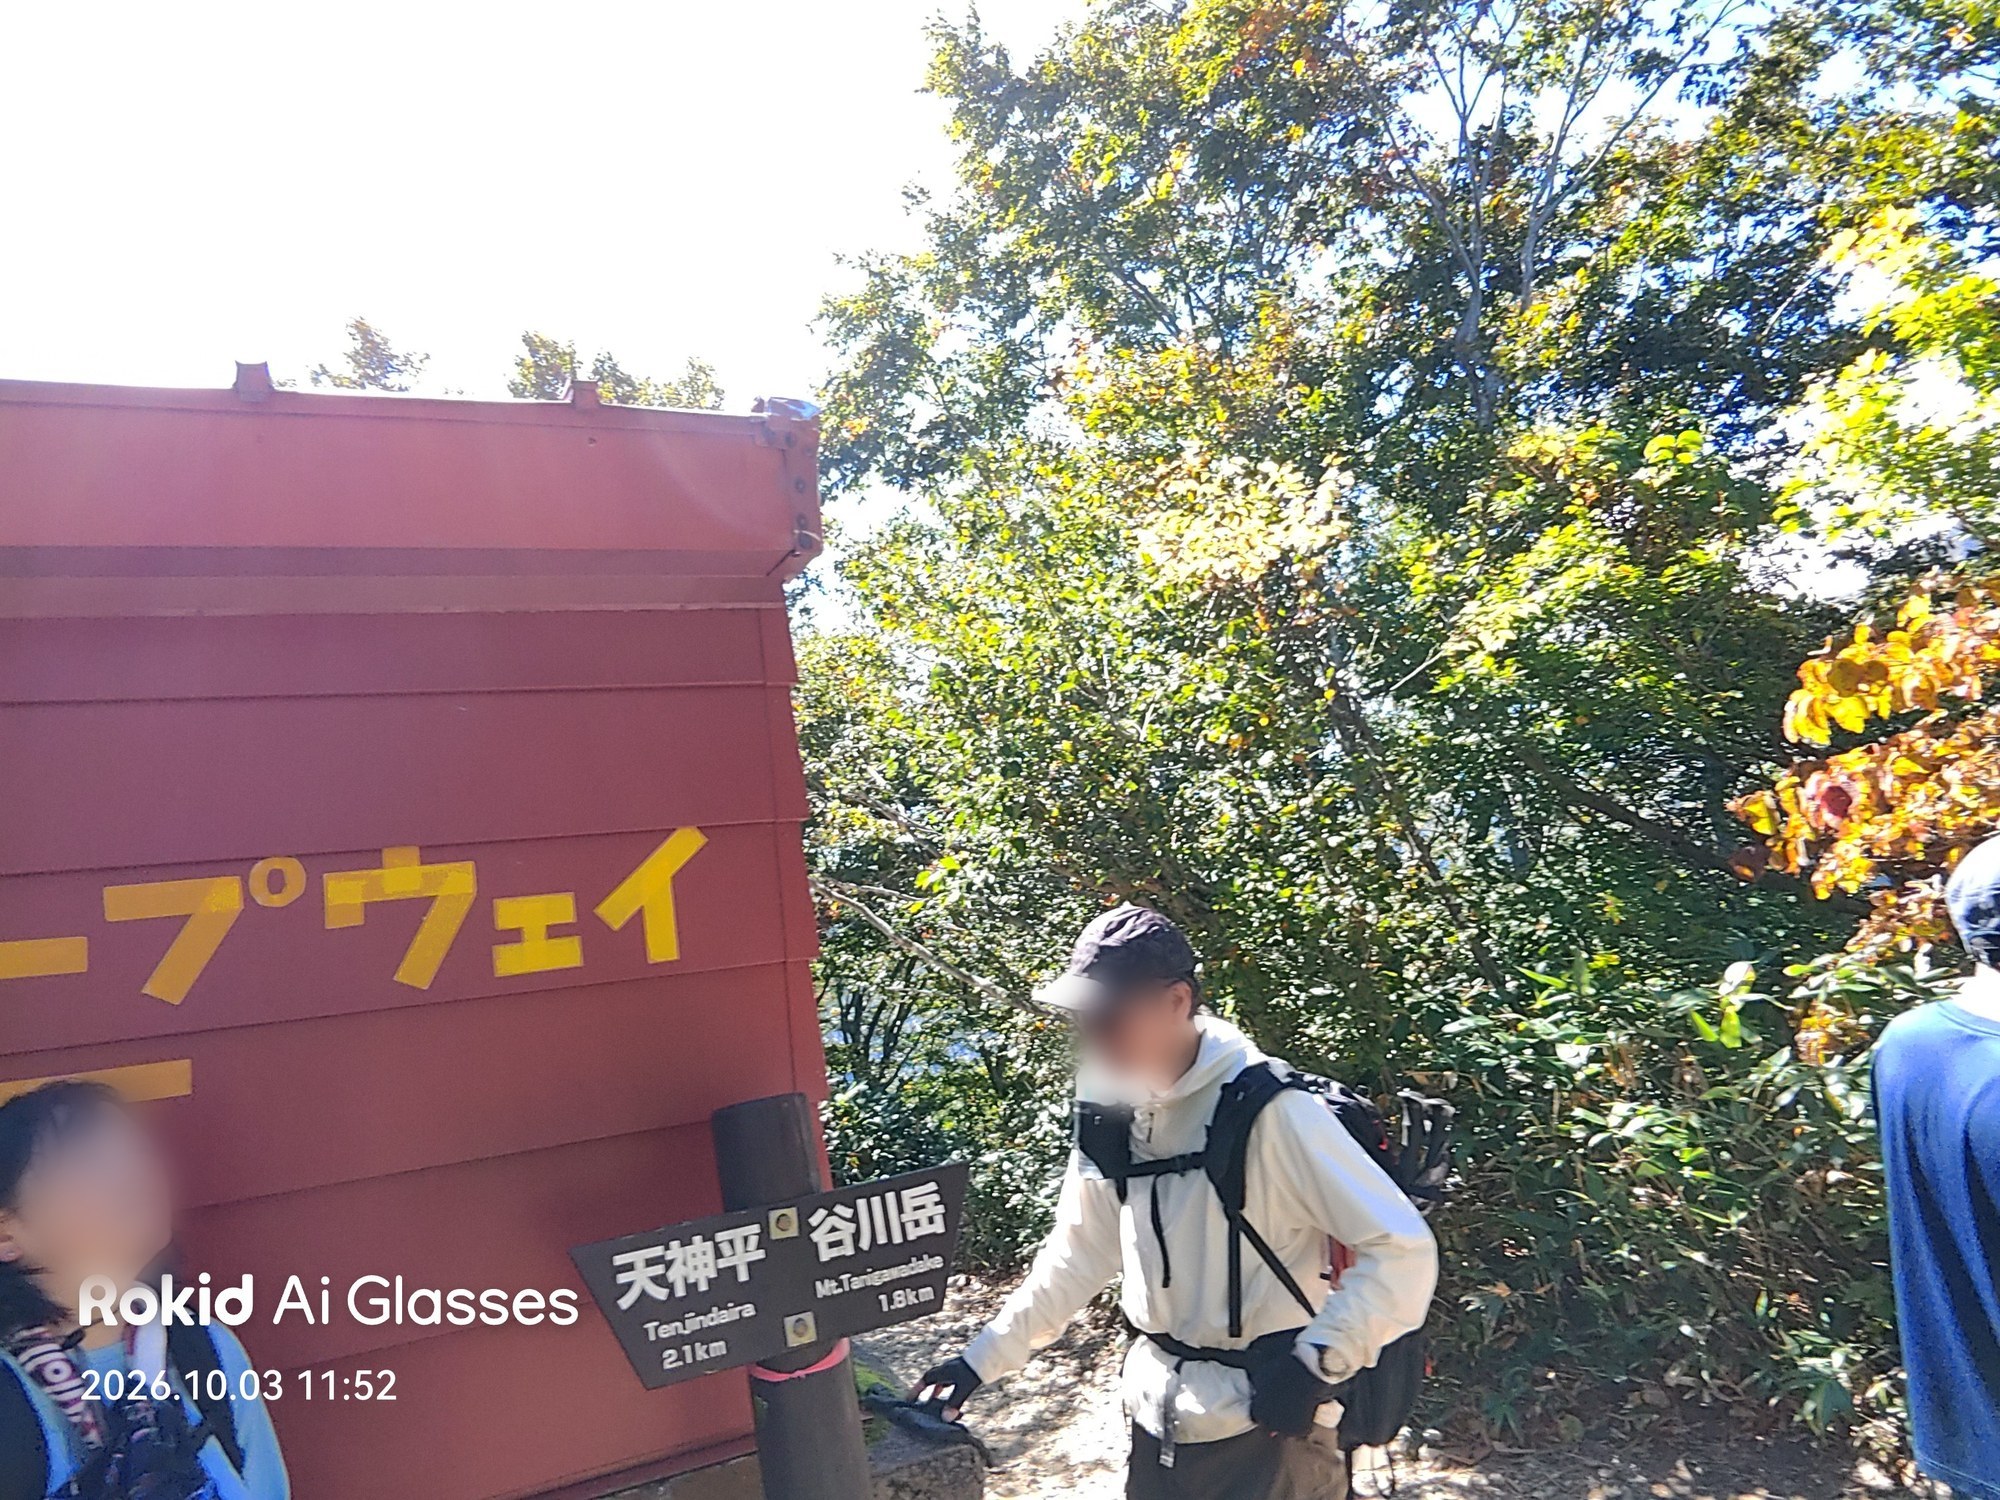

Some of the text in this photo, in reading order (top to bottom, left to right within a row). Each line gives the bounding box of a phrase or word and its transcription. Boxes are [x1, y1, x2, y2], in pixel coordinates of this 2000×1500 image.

[807, 1181, 946, 1262] 谷川岳
[613, 1223, 766, 1310] 天神平
[643, 1302, 757, 1341] Tenjindaira
